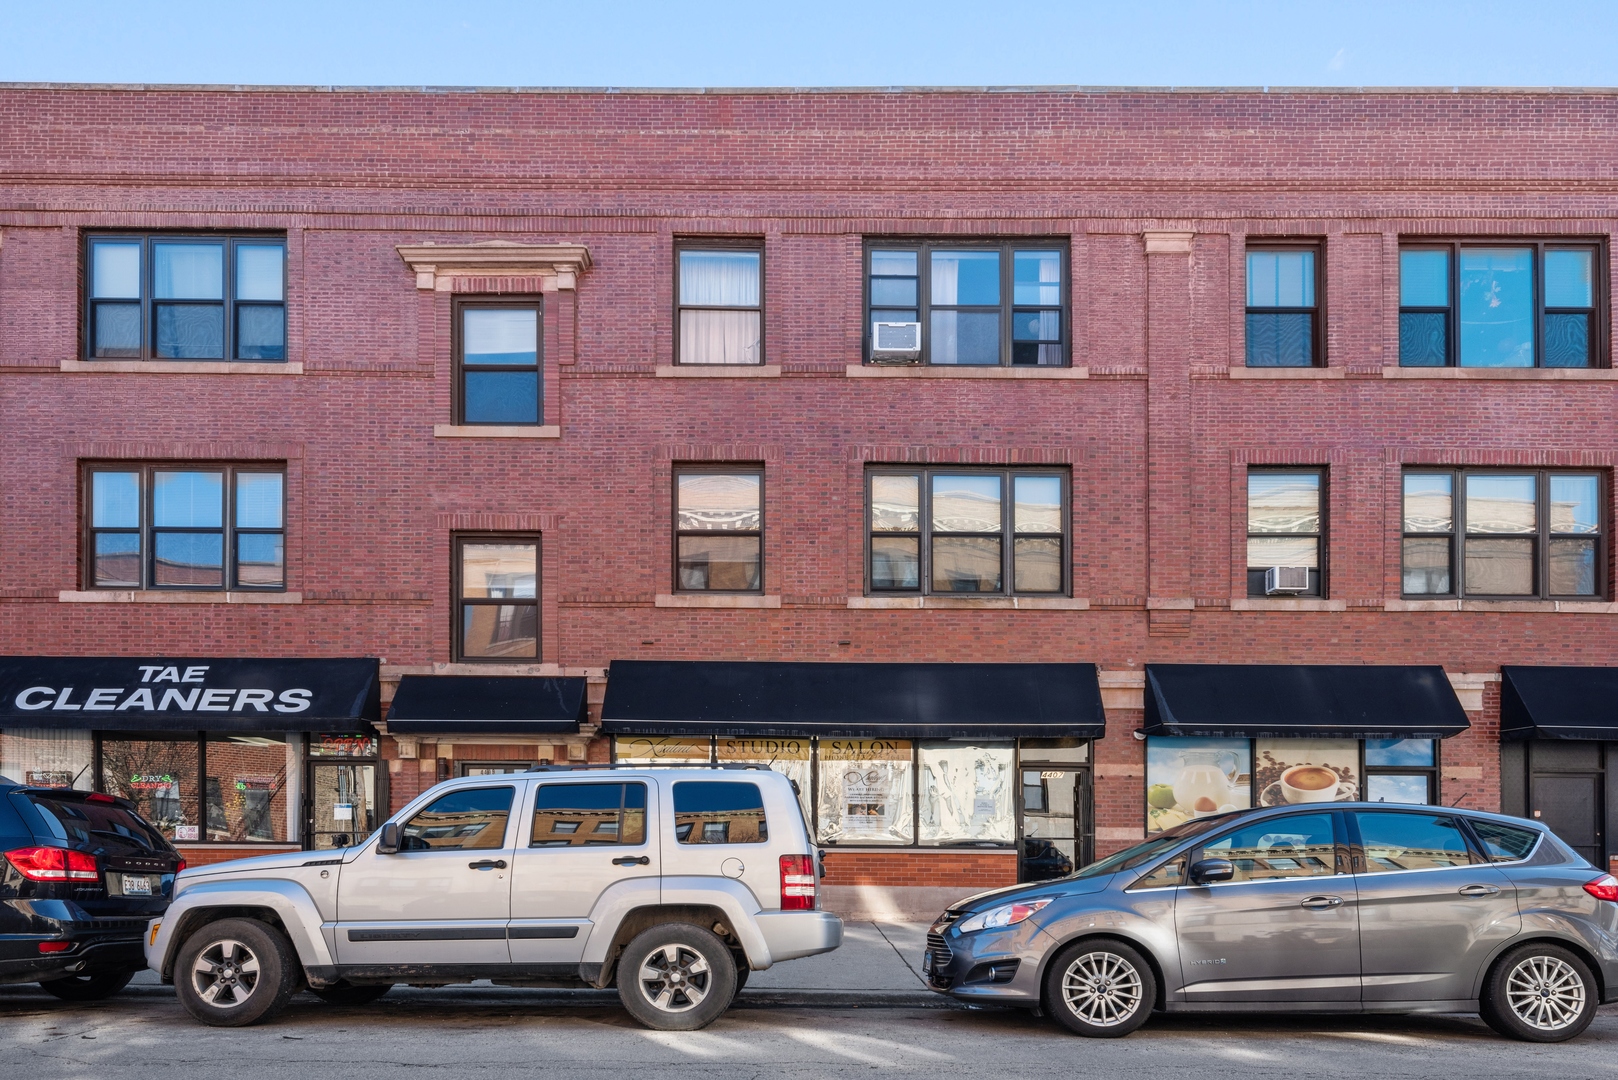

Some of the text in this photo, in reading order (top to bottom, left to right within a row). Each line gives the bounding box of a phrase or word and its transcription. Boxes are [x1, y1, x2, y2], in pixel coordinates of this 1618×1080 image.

[138, 666, 210, 682] TAE
[15, 686, 313, 713] CLEANERS
[322, 737, 371, 752] OPEN
[726, 740, 801, 755] STUDIO
[832, 741, 899, 755] SALON
